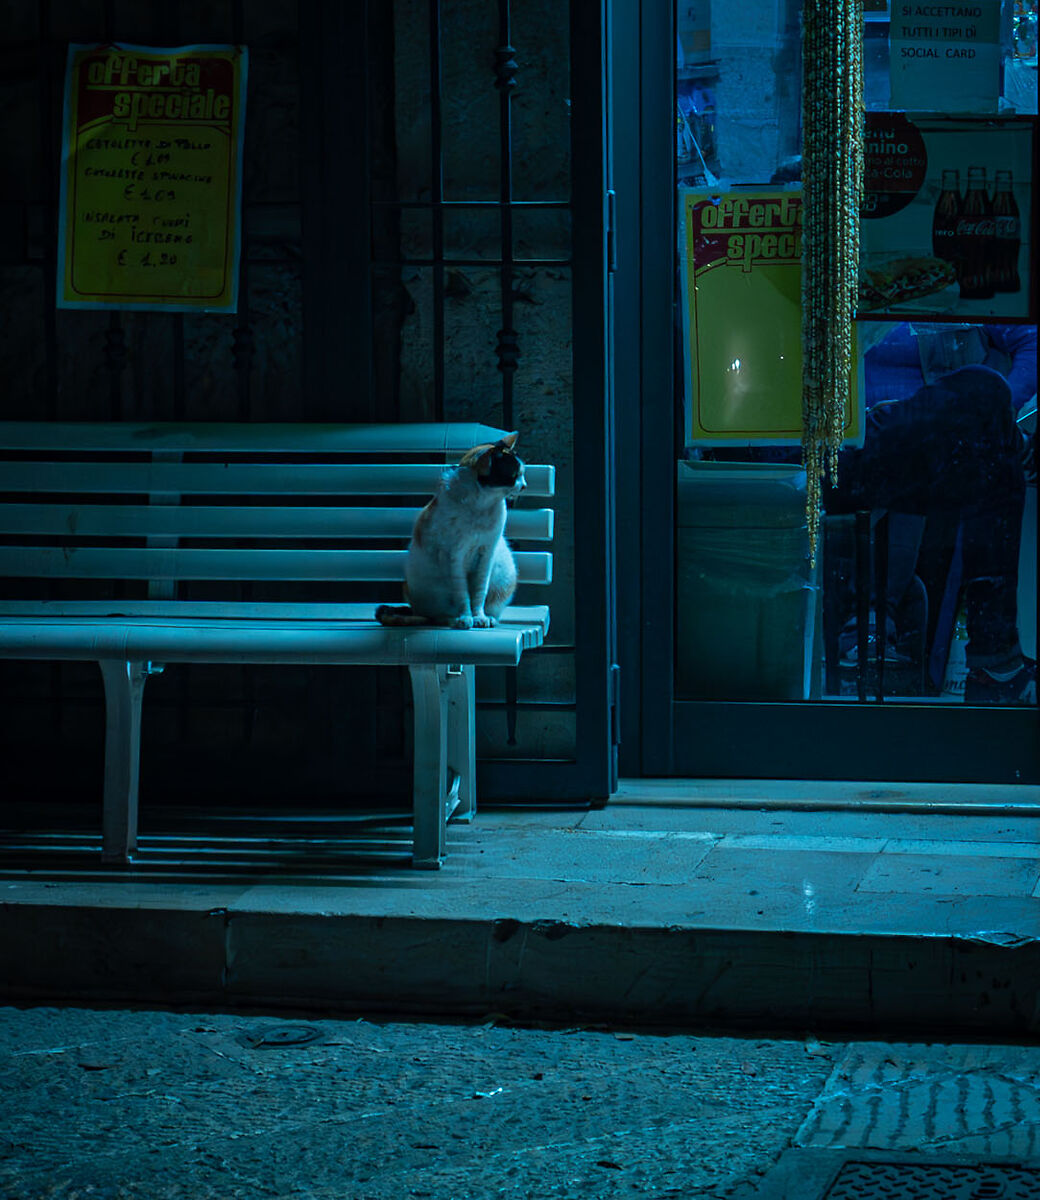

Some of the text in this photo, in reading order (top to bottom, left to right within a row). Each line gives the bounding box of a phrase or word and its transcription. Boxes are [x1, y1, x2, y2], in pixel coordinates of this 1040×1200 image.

[902, 6, 982, 18] SI ACCETTANO
[902, 26, 933, 38] TUTTI
[942, 27, 962, 38] TIPI
[901, 47, 976, 59] SOCIAL CARD
[87, 55, 201, 87] offerta
[113, 90, 231, 132] speciale
[727, 232, 802, 272] speci
